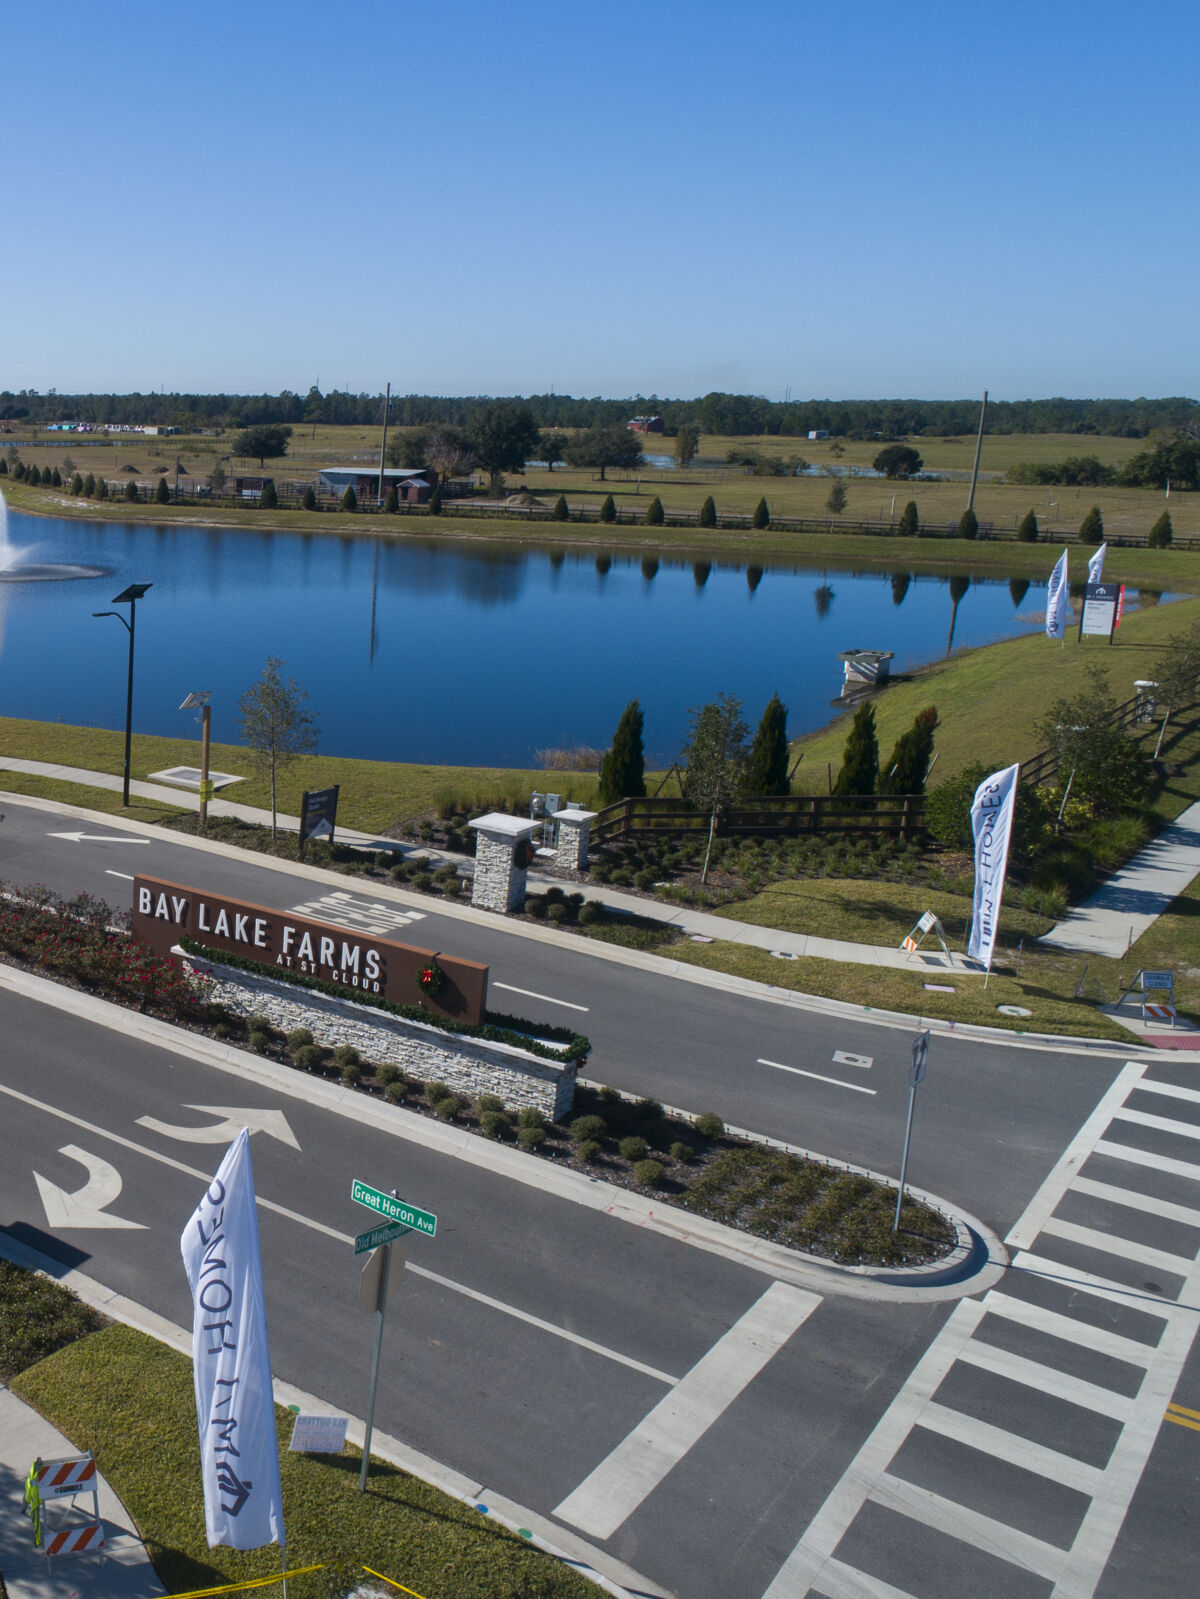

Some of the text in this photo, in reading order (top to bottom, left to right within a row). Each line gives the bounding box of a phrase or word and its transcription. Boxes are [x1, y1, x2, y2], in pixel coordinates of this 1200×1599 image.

[139, 887, 380, 979] BAY LAKE FARMS
[276, 954, 379, 992] AT ST CLOUD
[354, 1185, 434, 1231] Great Heron Ave
[356, 1235, 370, 1251] Old
